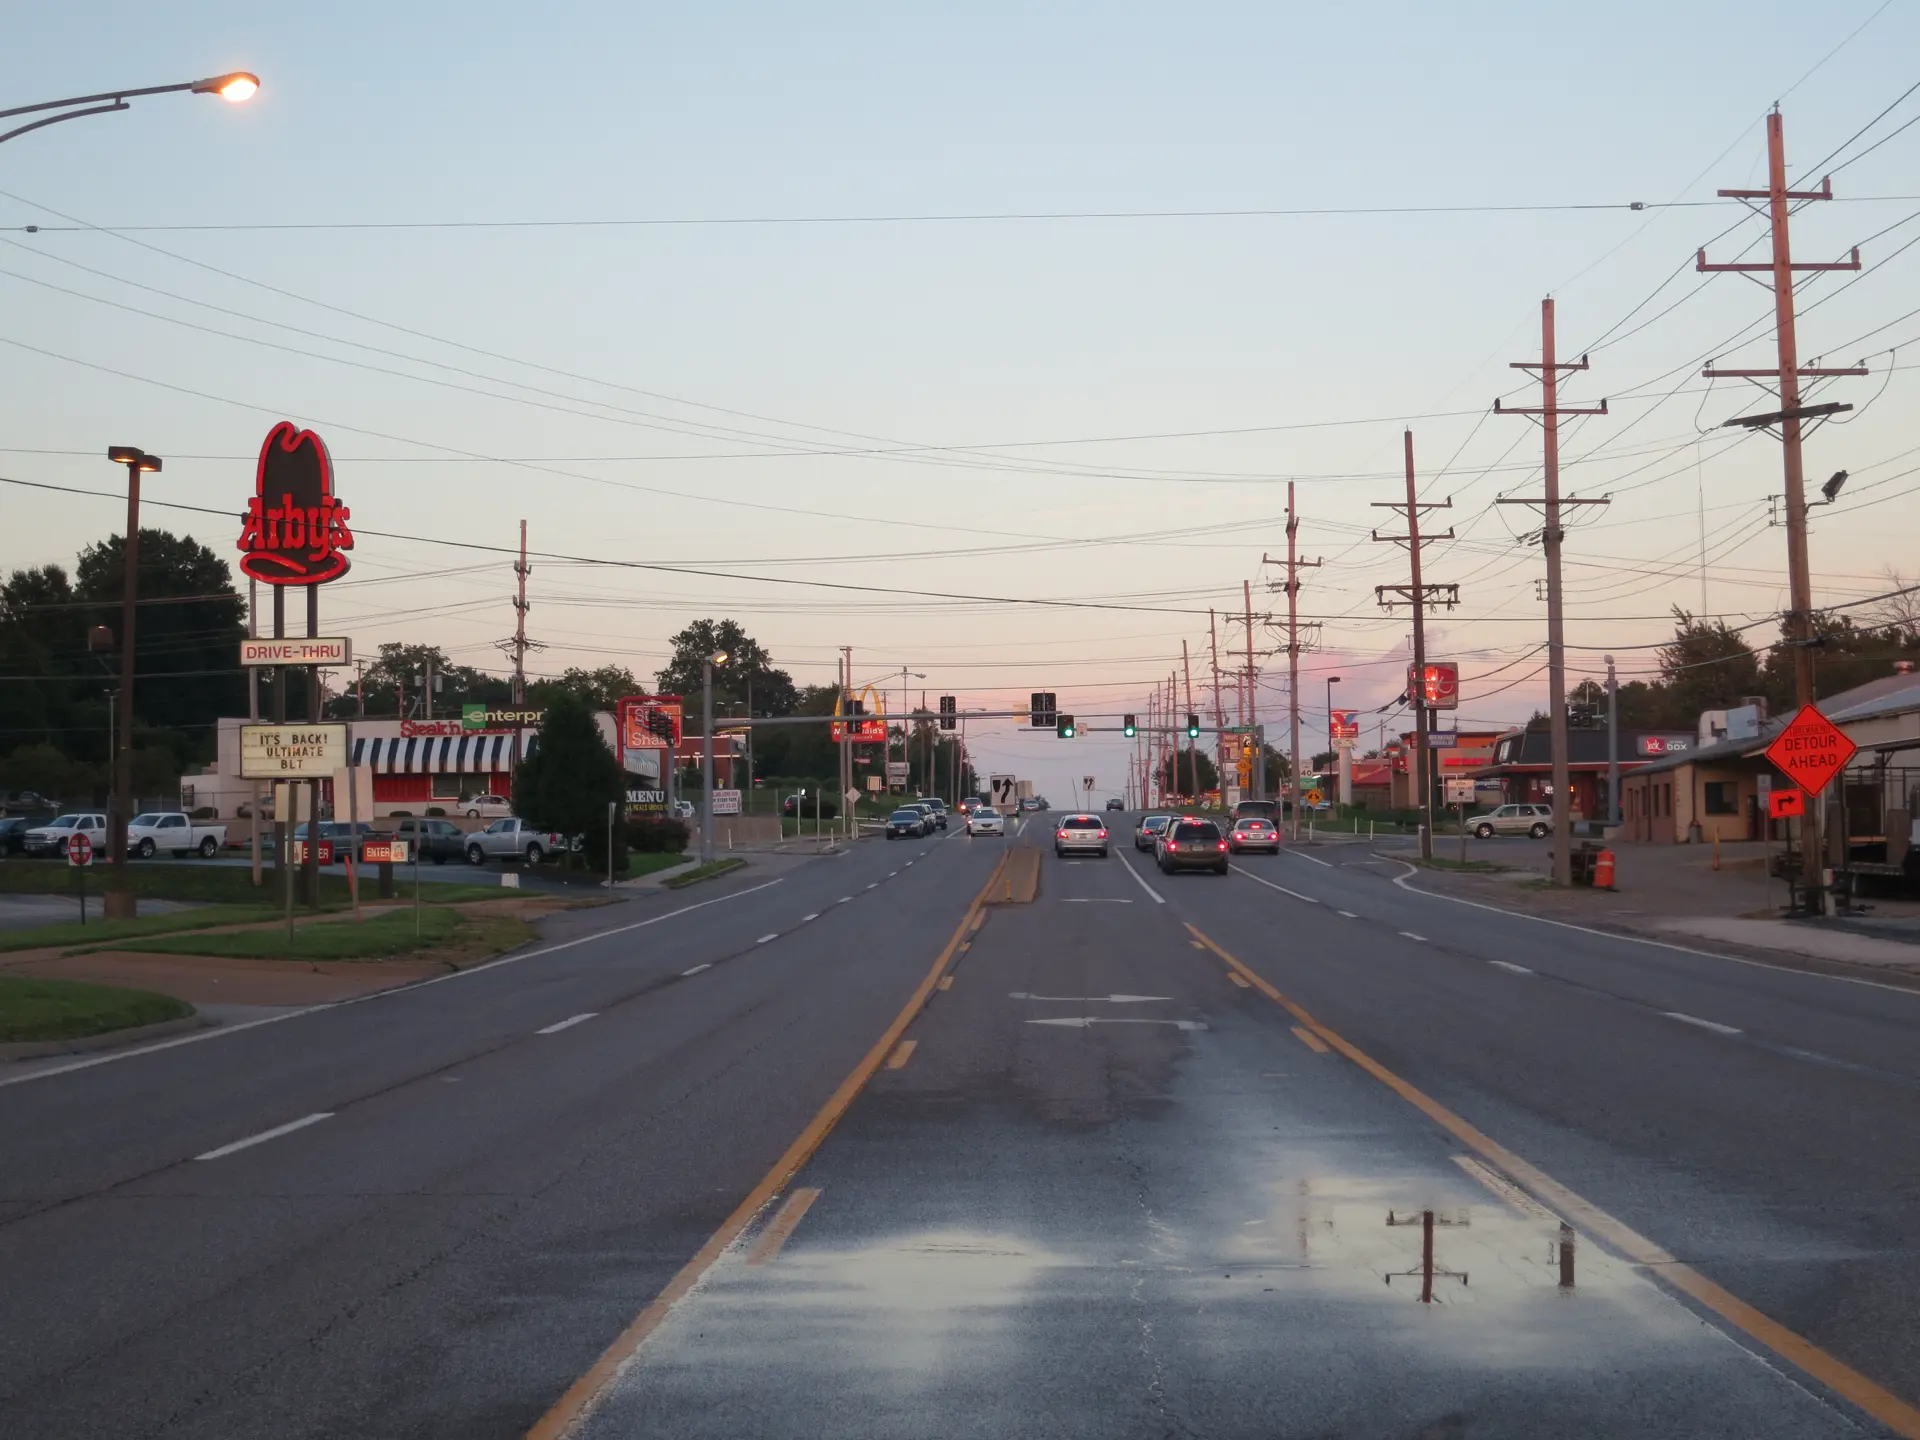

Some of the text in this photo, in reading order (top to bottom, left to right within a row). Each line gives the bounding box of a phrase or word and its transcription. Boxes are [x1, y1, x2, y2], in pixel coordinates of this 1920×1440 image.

[237, 493, 354, 562] Arby's
[246, 645, 341, 659] DRIVE-THRU
[400, 719, 447, 738] Steak
[260, 734, 328, 745] IT'S BACK!
[1784, 735, 1837, 751] DETOUR
[266, 746, 323, 757] ULTIMATE
[1666, 743, 1687, 751] box
[281, 759, 303, 769] BLT
[1788, 753, 1837, 769] AHEAD
[1300, 769, 1312, 777] 40
[625, 790, 665, 803] MENU
[366, 847, 391, 857] ENTER
